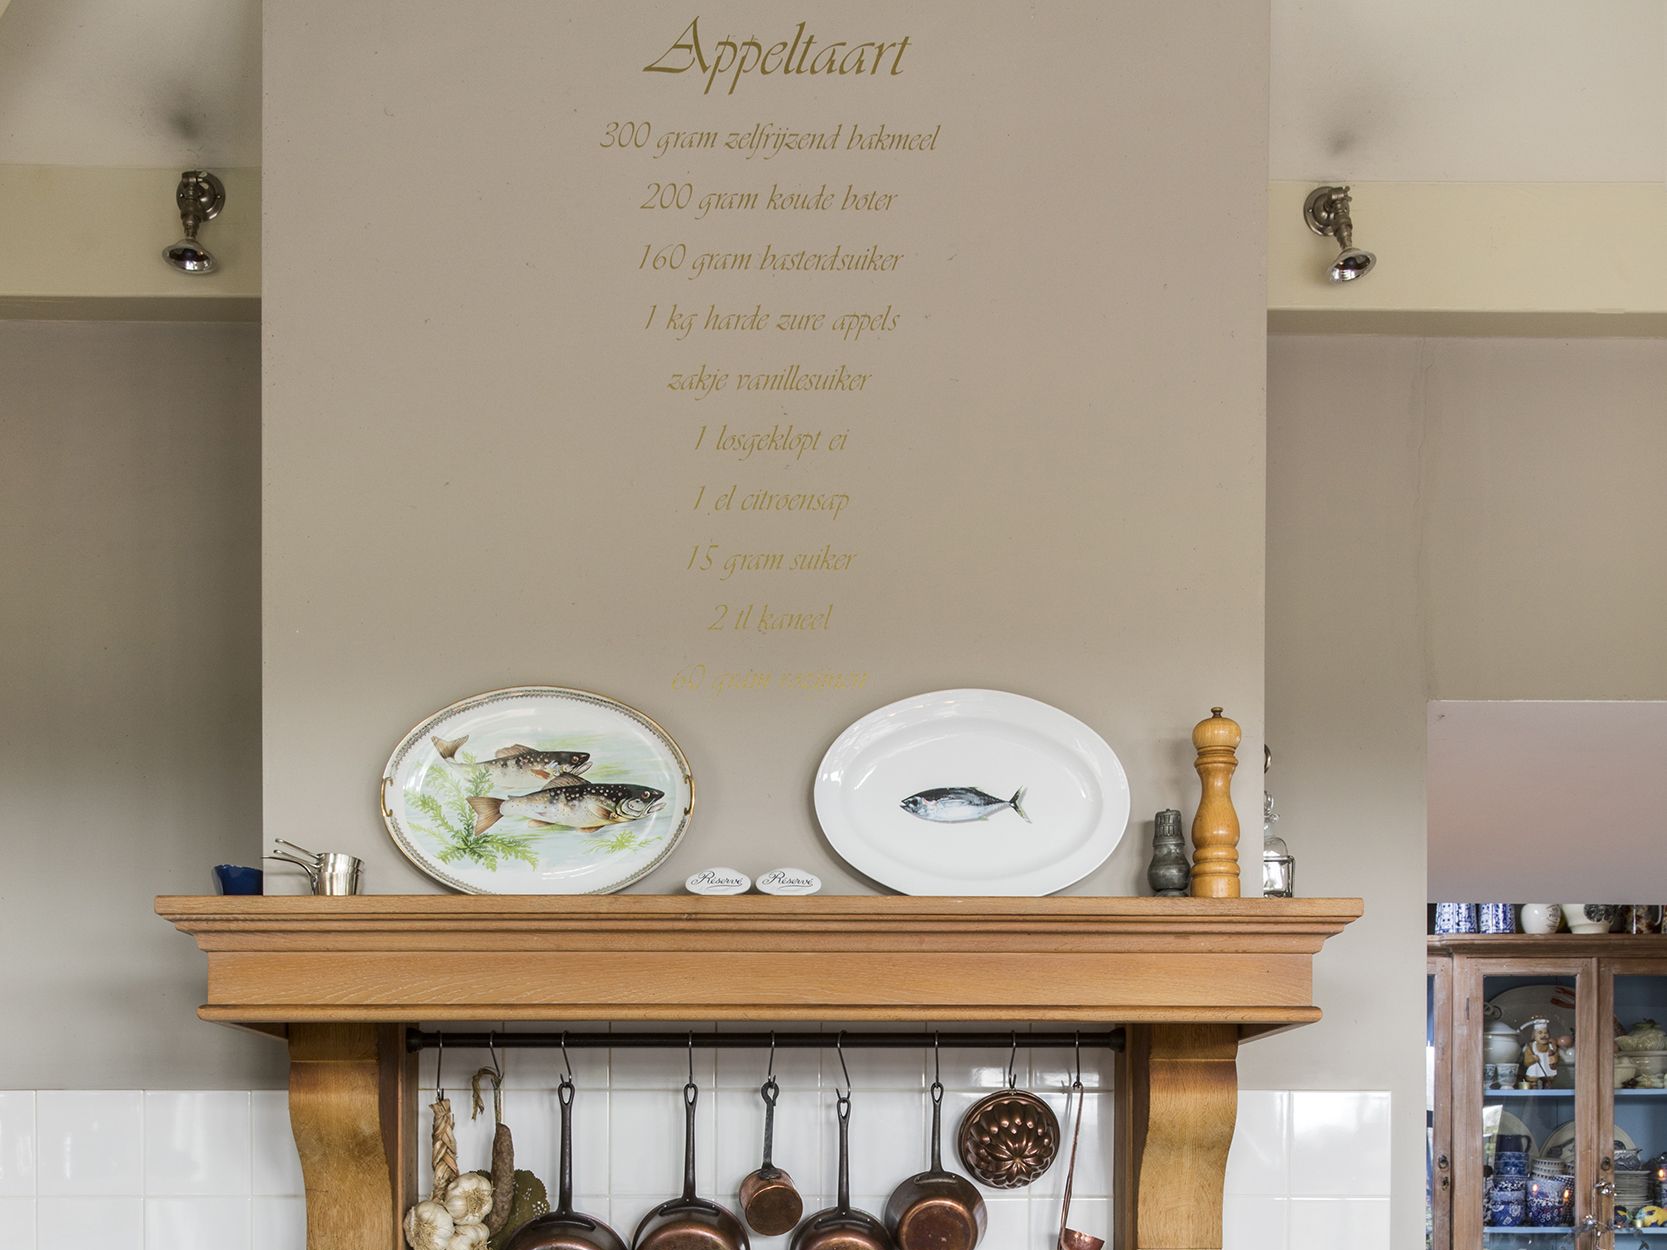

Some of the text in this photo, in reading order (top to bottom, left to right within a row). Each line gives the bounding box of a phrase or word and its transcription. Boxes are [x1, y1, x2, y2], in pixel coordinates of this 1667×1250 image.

[642, 16, 912, 96] Appeltaart
[599, 121, 941, 160] 300 gram zelfrijzend bakmeel
[640, 182, 898, 220] 200 gram koude boter
[638, 243, 904, 281] 160 gram basterdsuiker
[645, 304, 900, 341] 1 kg harde zure appels
[667, 364, 872, 401] zakje vanillesuiker
[695, 424, 850, 461] 1 losgeklopt ei
[693, 485, 849, 520] 1 el citroensap
[686, 544, 858, 581] 15 gram suiker
[708, 603, 833, 632] 2 tl kaneel
